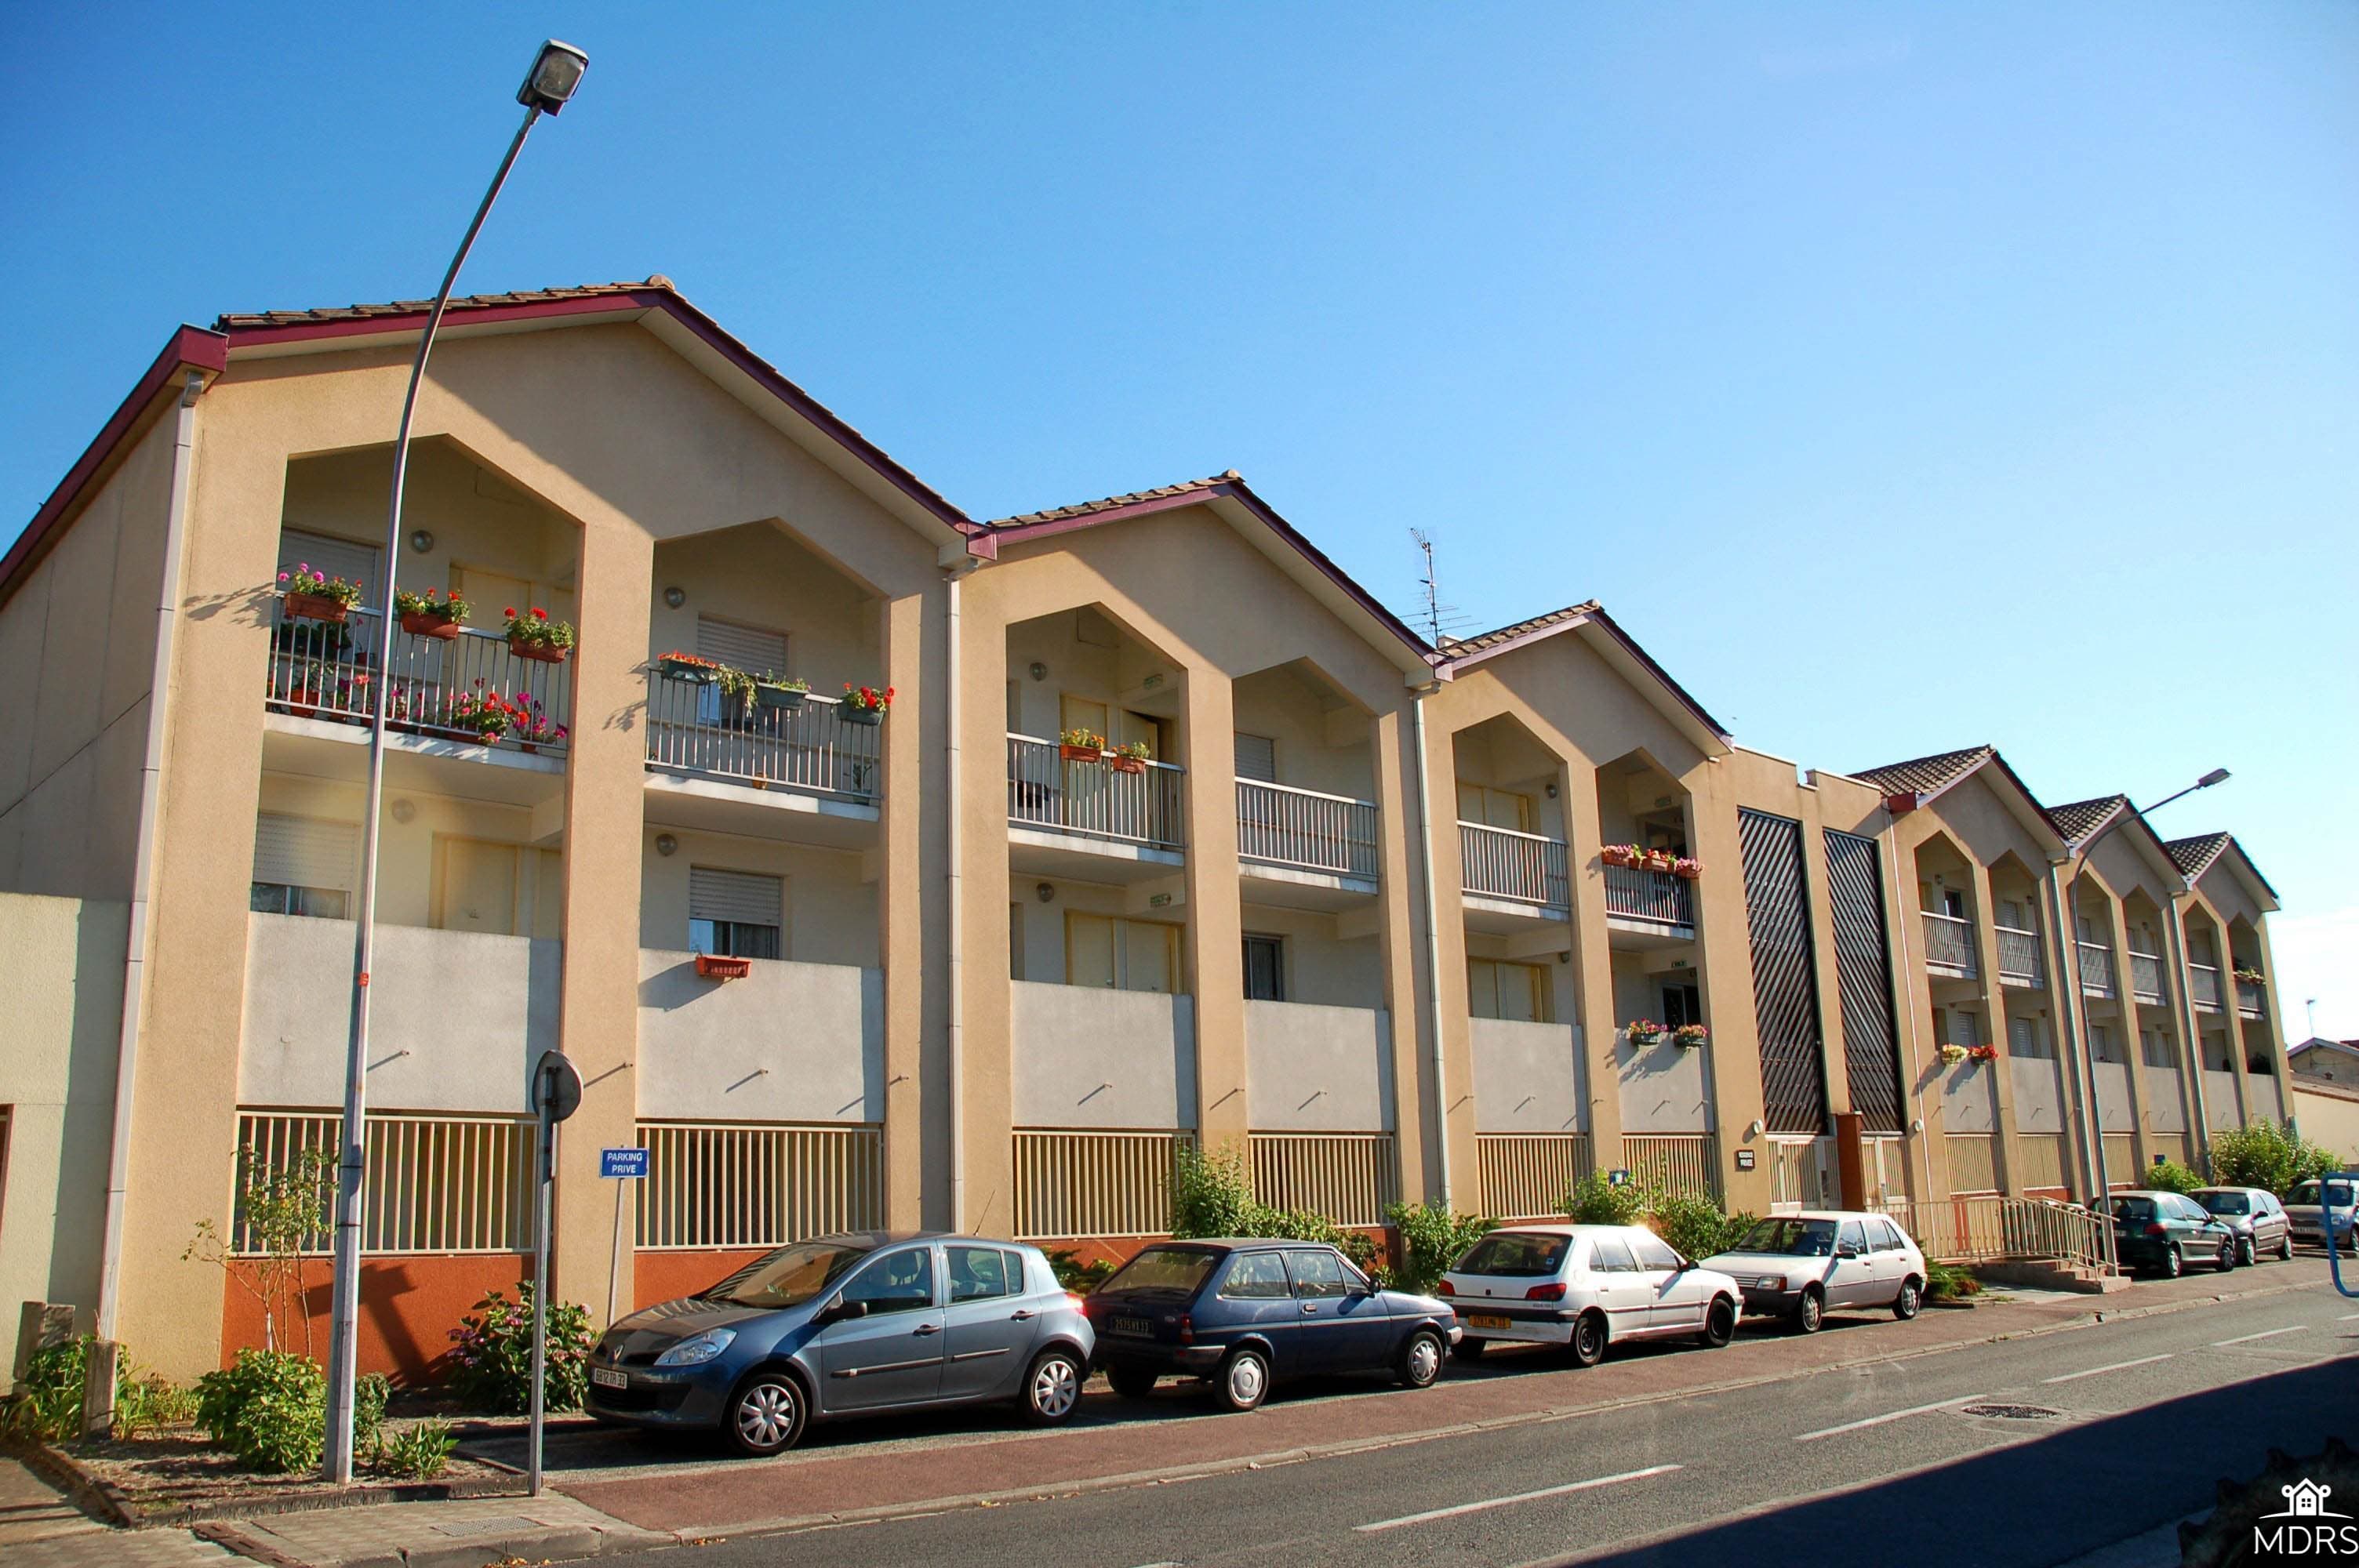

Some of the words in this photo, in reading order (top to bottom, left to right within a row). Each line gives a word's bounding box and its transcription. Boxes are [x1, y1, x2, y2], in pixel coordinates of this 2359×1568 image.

[607, 1152, 642, 1161] PARKING
[612, 1164, 636, 1174] PRIVE
[618, 1374, 626, 1388] 33
